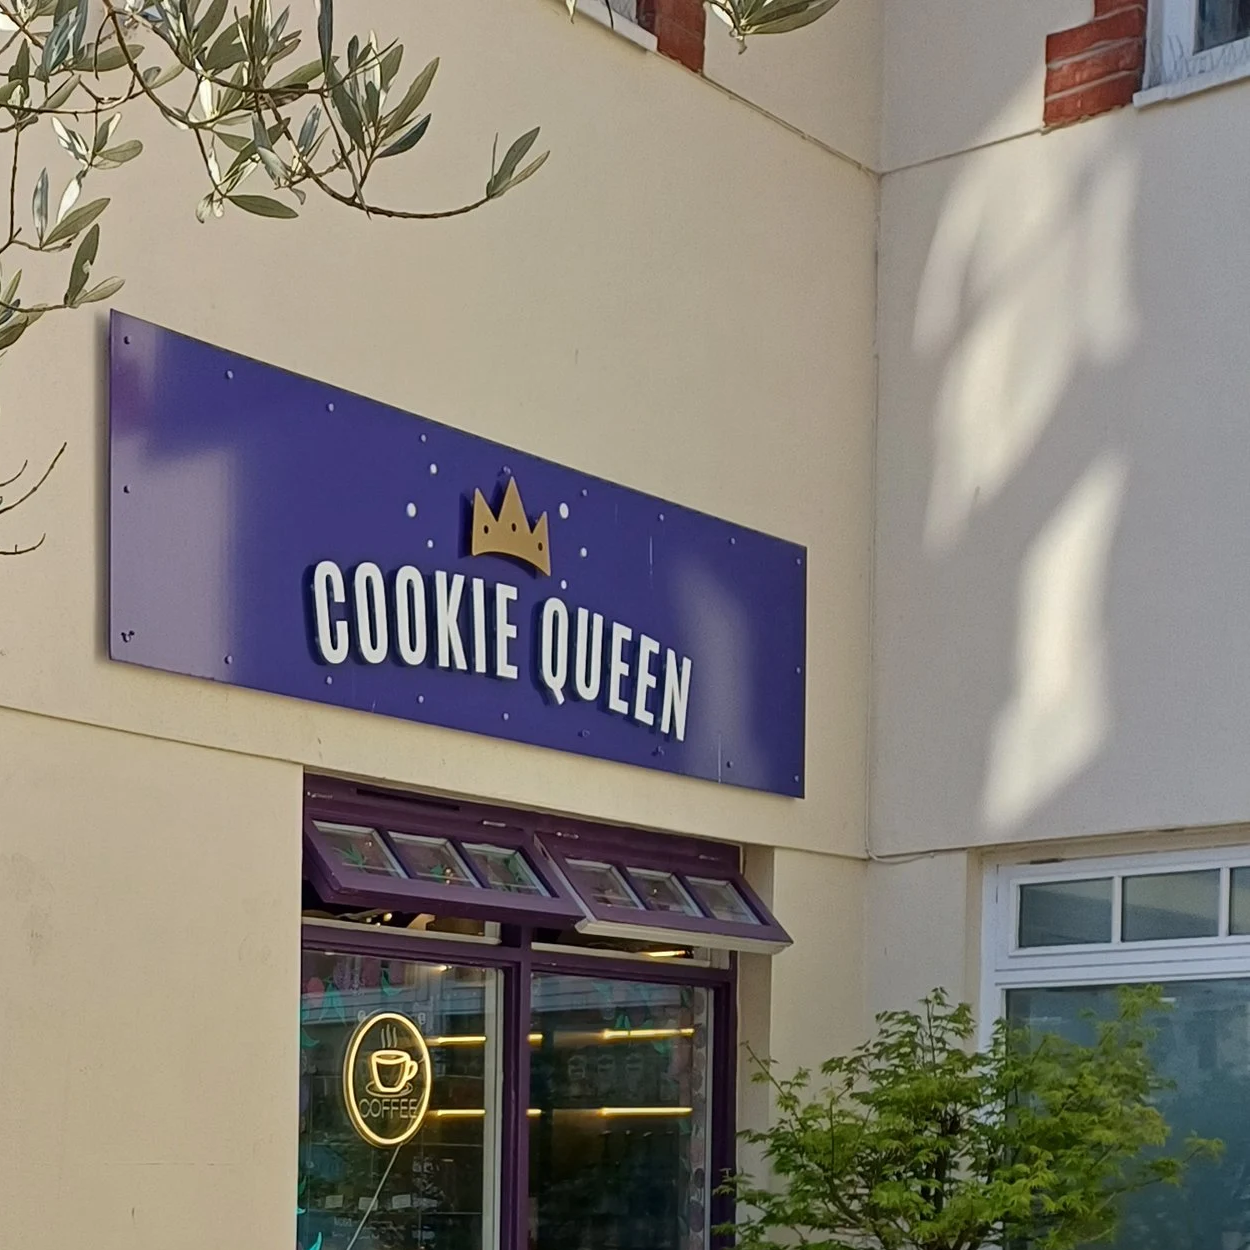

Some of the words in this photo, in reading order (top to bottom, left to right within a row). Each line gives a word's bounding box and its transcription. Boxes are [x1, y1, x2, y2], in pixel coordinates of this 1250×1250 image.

[314, 560, 518, 680] COOKIE
[542, 597, 692, 741] QUEEN
[358, 1098, 418, 1119] COFFEE
